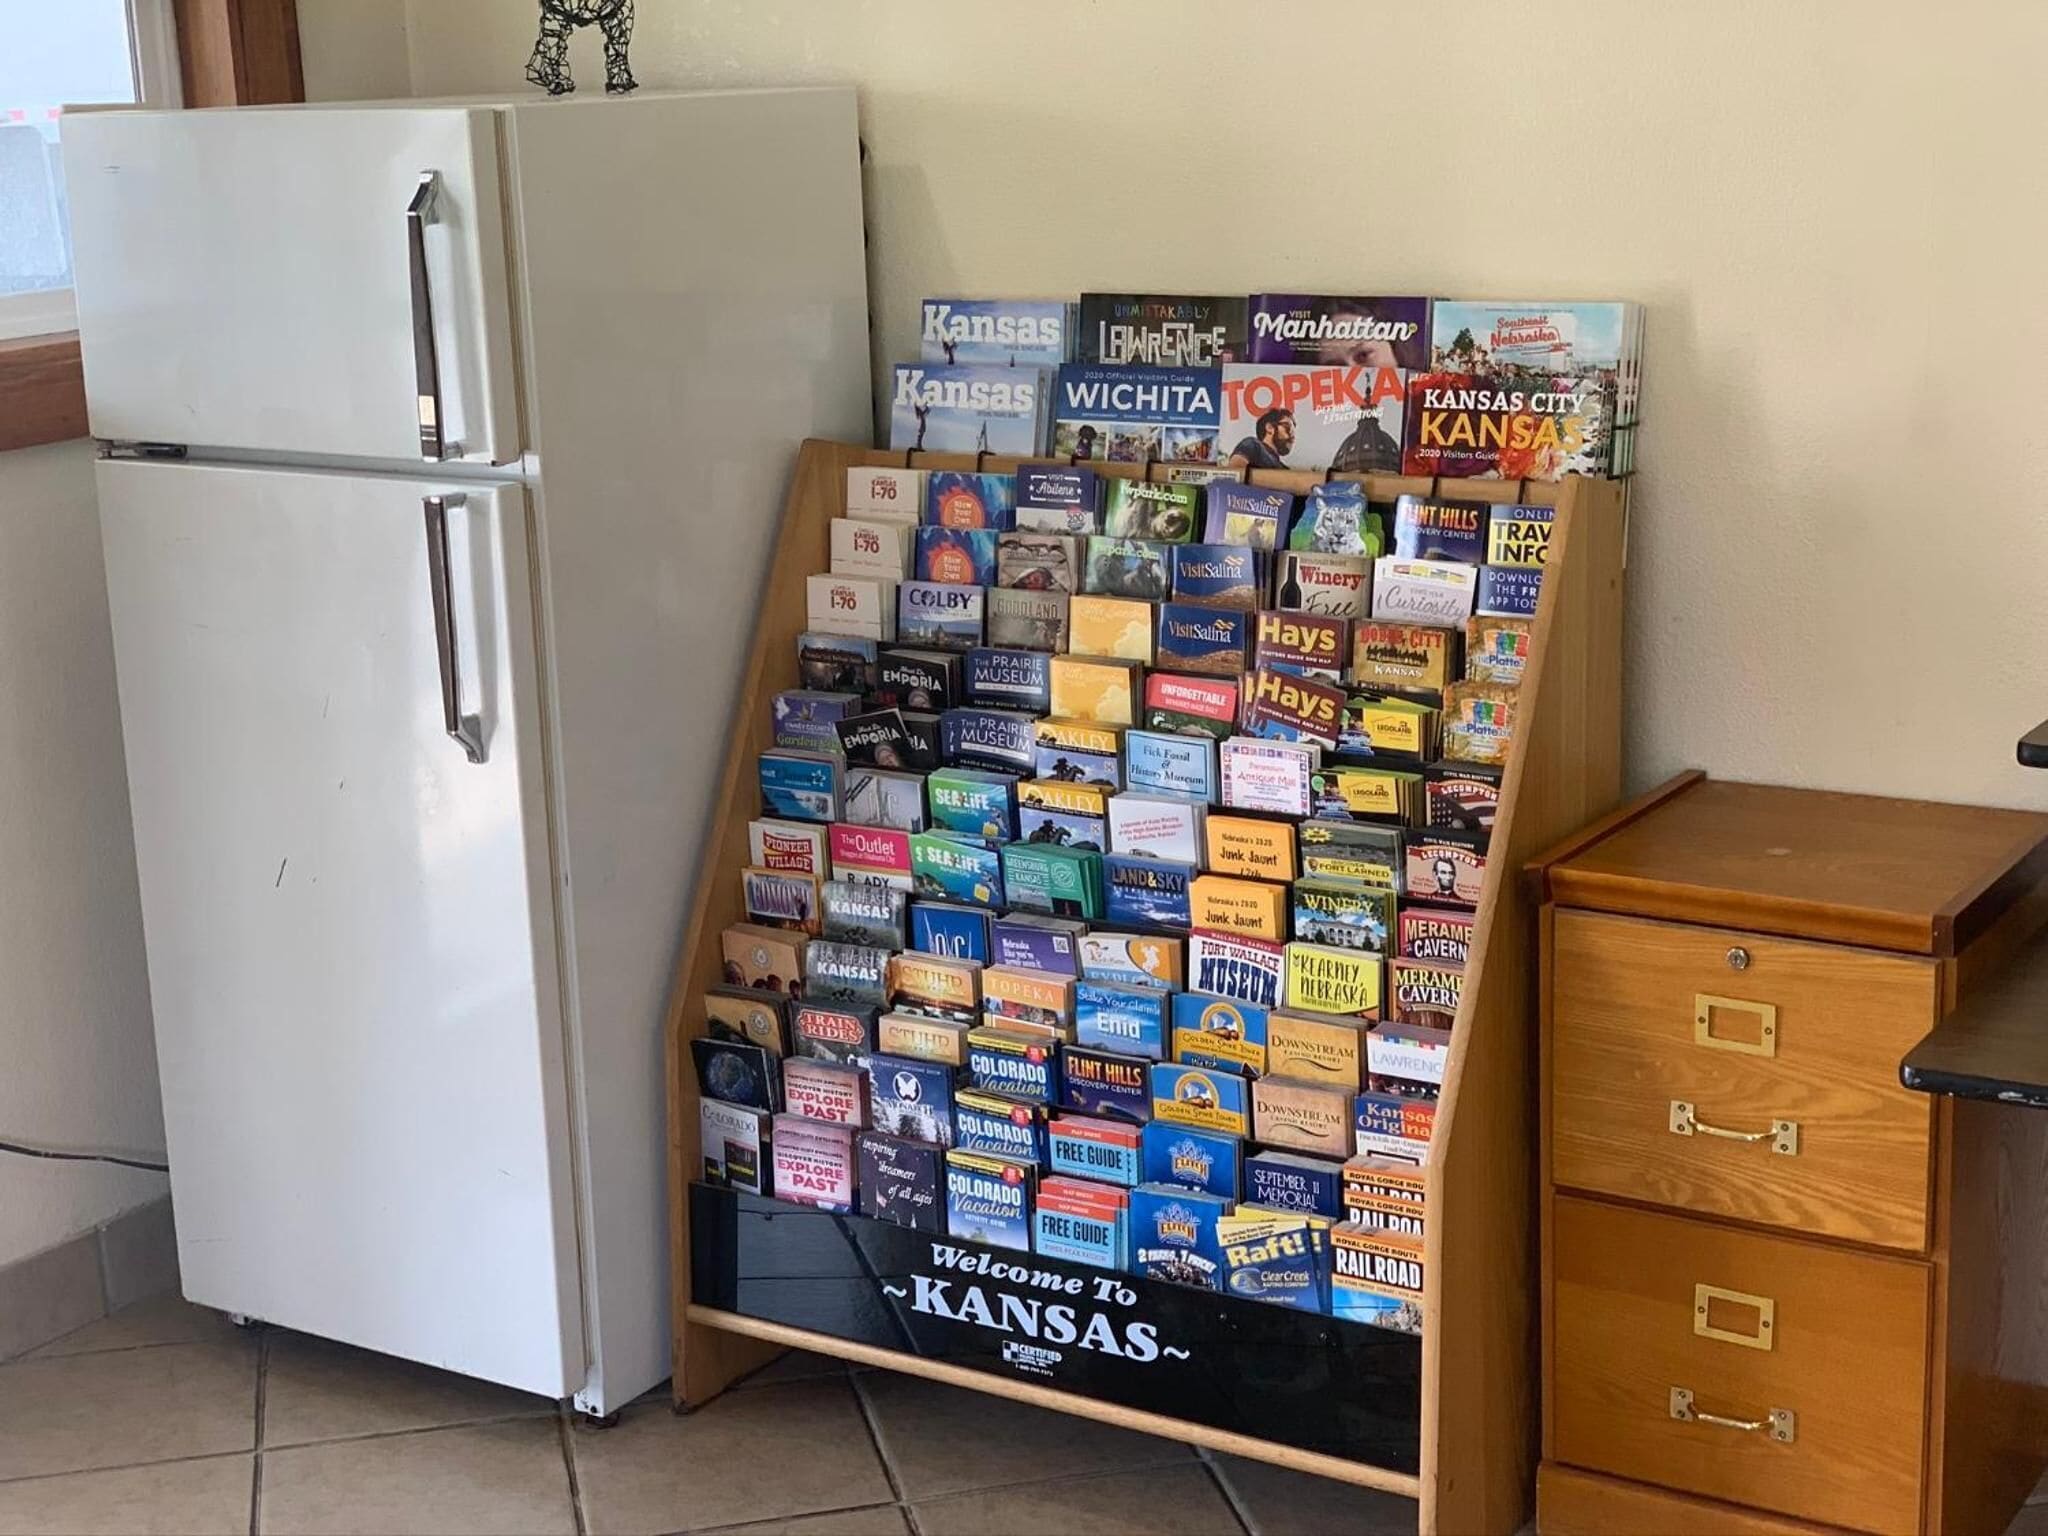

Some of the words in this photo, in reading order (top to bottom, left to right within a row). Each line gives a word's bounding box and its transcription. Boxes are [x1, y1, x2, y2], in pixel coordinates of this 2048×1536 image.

[922, 304, 1061, 346] Kansas
[1253, 312, 1410, 343] Manhattan
[1100, 320, 1226, 367] LAWRENCE
[1490, 330, 1559, 347] Nebraska
[1138, 372, 1168, 382] Visitors
[1171, 374, 1195, 383] Guide
[896, 369, 1034, 412] Kansas
[1065, 382, 1214, 414] WICHITA
[1221, 366, 1407, 421] TOPEKA
[1424, 389, 1523, 410] KANSAS
[1530, 391, 1586, 413] CITY
[1420, 412, 1586, 452] KANSAS
[1419, 448, 1441, 458] 2020
[1443, 449, 1474, 460] Visitors
[1475, 451, 1500, 461] Guide
[871, 487, 897, 499] I-70
[1036, 481, 1074, 496] Abilene
[1440, 507, 1478, 530] HILLS
[1514, 509, 1554, 519] ONLIN
[1443, 529, 1476, 540] CENTER
[1494, 522, 1552, 542] TRAV
[854, 540, 879, 553] I-70
[1300, 565, 1366, 590] Winery
[1489, 572, 1542, 584] DOWNLO
[909, 588, 972, 609] COLBY
[1496, 584, 1516, 595] THE
[1522, 585, 1536, 596] FR
[831, 597, 856, 610] I-70
[1306, 591, 1357, 617] Free
[1385, 585, 1465, 618] Curiosity
[1489, 597, 1508, 606] APP
[1259, 615, 1336, 652] Hays
[975, 659, 990, 667] THE
[993, 656, 1043, 670] PRAIRIE
[1375, 665, 1423, 677] KANSAS
[883, 670, 942, 691] EMPORIA
[975, 668, 1044, 685] MUSEUM
[1162, 683, 1226, 705] UNFORGETTABLE
[1259, 671, 1335, 721] Hays
[961, 719, 976, 728] THE
[980, 718, 1030, 737] PRAIRIE
[844, 728, 901, 749] EMPORIA
[960, 728, 1030, 752] MUSEUM
[1163, 750, 1190, 762] Fossil
[1164, 770, 1204, 785] Museum
[1441, 786, 1498, 800] LECOMPTON
[765, 836, 811, 853] PIONEER
[840, 833, 855, 845] The
[855, 835, 895, 856] Outlet
[767, 855, 811, 870] VILLAGE
[1220, 849, 1245, 862] Junk
[1249, 849, 1278, 867] Jaunt
[1421, 852, 1478, 867] LECOMPTON
[1112, 866, 1183, 891] LAND&SKY
[1319, 863, 1347, 872] FORT
[1348, 867, 1390, 879] LARNED
[830, 901, 890, 920] KANSAS
[1303, 893, 1375, 914] WINERY
[1205, 910, 1230, 924] Junk
[1234, 913, 1263, 929] Jaunt
[1405, 919, 1473, 941] MERAME
[1201, 941, 1227, 955] FORT
[1228, 946, 1280, 972] WALLACE
[1414, 939, 1467, 962] CAVERN
[817, 961, 878, 981] KANSAS
[1199, 956, 1278, 1007] MUSEUM
[1396, 970, 1462, 990] MERAME
[992, 979, 1054, 999] TOPEKA
[1300, 978, 1368, 1007] NEBRASKA
[1399, 986, 1459, 1007] CAVERN
[805, 1013, 856, 1028] TRAIN
[1097, 1012, 1141, 1039] Enid
[805, 1026, 859, 1041] RIDES
[1271, 1034, 1354, 1059] DOWNSTREAM
[970, 1054, 1046, 1083] COLORADO
[1068, 1055, 1101, 1080] FLINT
[1105, 1063, 1142, 1087] HILLS
[1372, 1050, 1441, 1075] LAWRENC
[973, 1073, 1048, 1097] Vacation
[1069, 1076, 1110, 1091] DISCOVERY
[1111, 1085, 1143, 1097] CENTER
[788, 1088, 854, 1109] EXPLORE
[803, 1104, 849, 1122] PAST
[1257, 1101, 1341, 1125] DOWNSTREAM
[1367, 1103, 1433, 1124] Kansas
[957, 1114, 1033, 1144] COLORADO
[1358, 1115, 1430, 1138] Origina
[962, 1132, 1035, 1157] Vacation
[1056, 1140, 1084, 1163] FREE
[1088, 1146, 1123, 1170] GUIDE
[778, 1159, 844, 1180] EXPLORE
[792, 1174, 838, 1193] PAST
[948, 1172, 1021, 1206] COLORADO
[1254, 1170, 1307, 1192] SEPTEMBER
[888, 1184, 898, 1201] of
[899, 1188, 911, 1200] all
[913, 1192, 933, 1206] ages
[1258, 1185, 1318, 1210] MEMORIAL
[950, 1191, 1022, 1221] Vacation
[1042, 1214, 1070, 1239] FREE
[1074, 1220, 1109, 1246] GUIDE
[1226, 1233, 1306, 1268] Raft!
[1336, 1237, 1361, 1248] ROYAL
[1363, 1243, 1390, 1254] GORGE
[931, 1243, 1084, 1295] Welcome
[1092, 1276, 1137, 1307] To
[1336, 1248, 1421, 1289] RAILROAD
